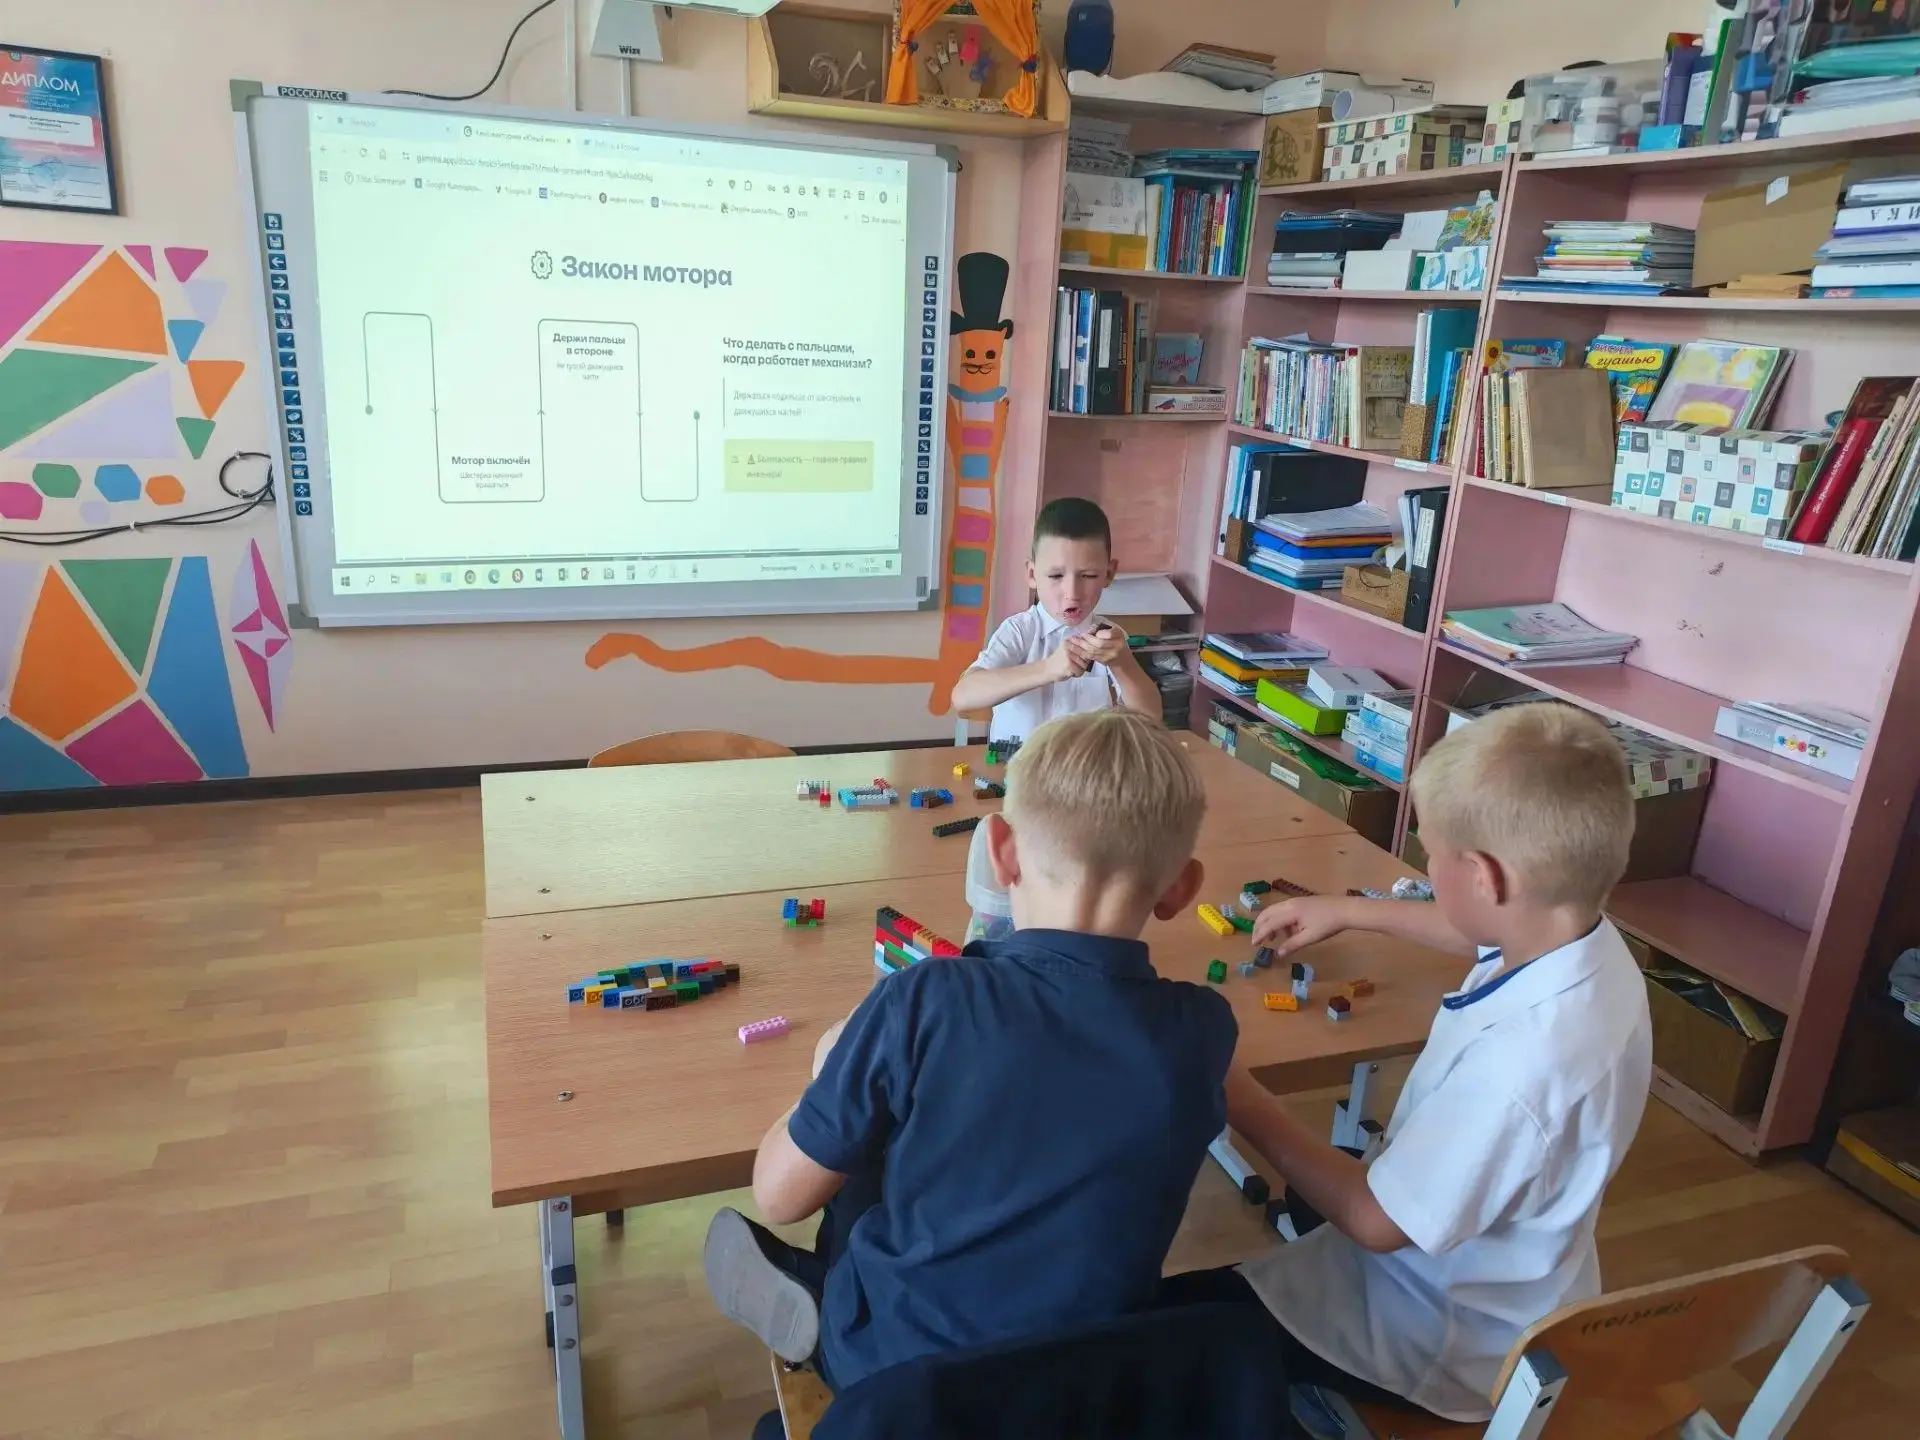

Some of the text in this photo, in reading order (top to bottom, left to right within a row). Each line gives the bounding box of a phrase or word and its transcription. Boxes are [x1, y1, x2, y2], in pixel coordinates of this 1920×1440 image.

[2, 72, 80, 96] ДИПЛОМ
[281, 87, 344, 101] РОССКЛАСС
[561, 254, 732, 288] Закон мотора
[552, 333, 626, 345] Держи пальцы
[722, 337, 855, 355] Что делать с пальцами,
[566, 347, 614, 357] в стороне
[722, 353, 873, 369] когда работает механизм?
[1596, 355, 1656, 367] гуашью
[451, 455, 531, 467] Мотор включён
